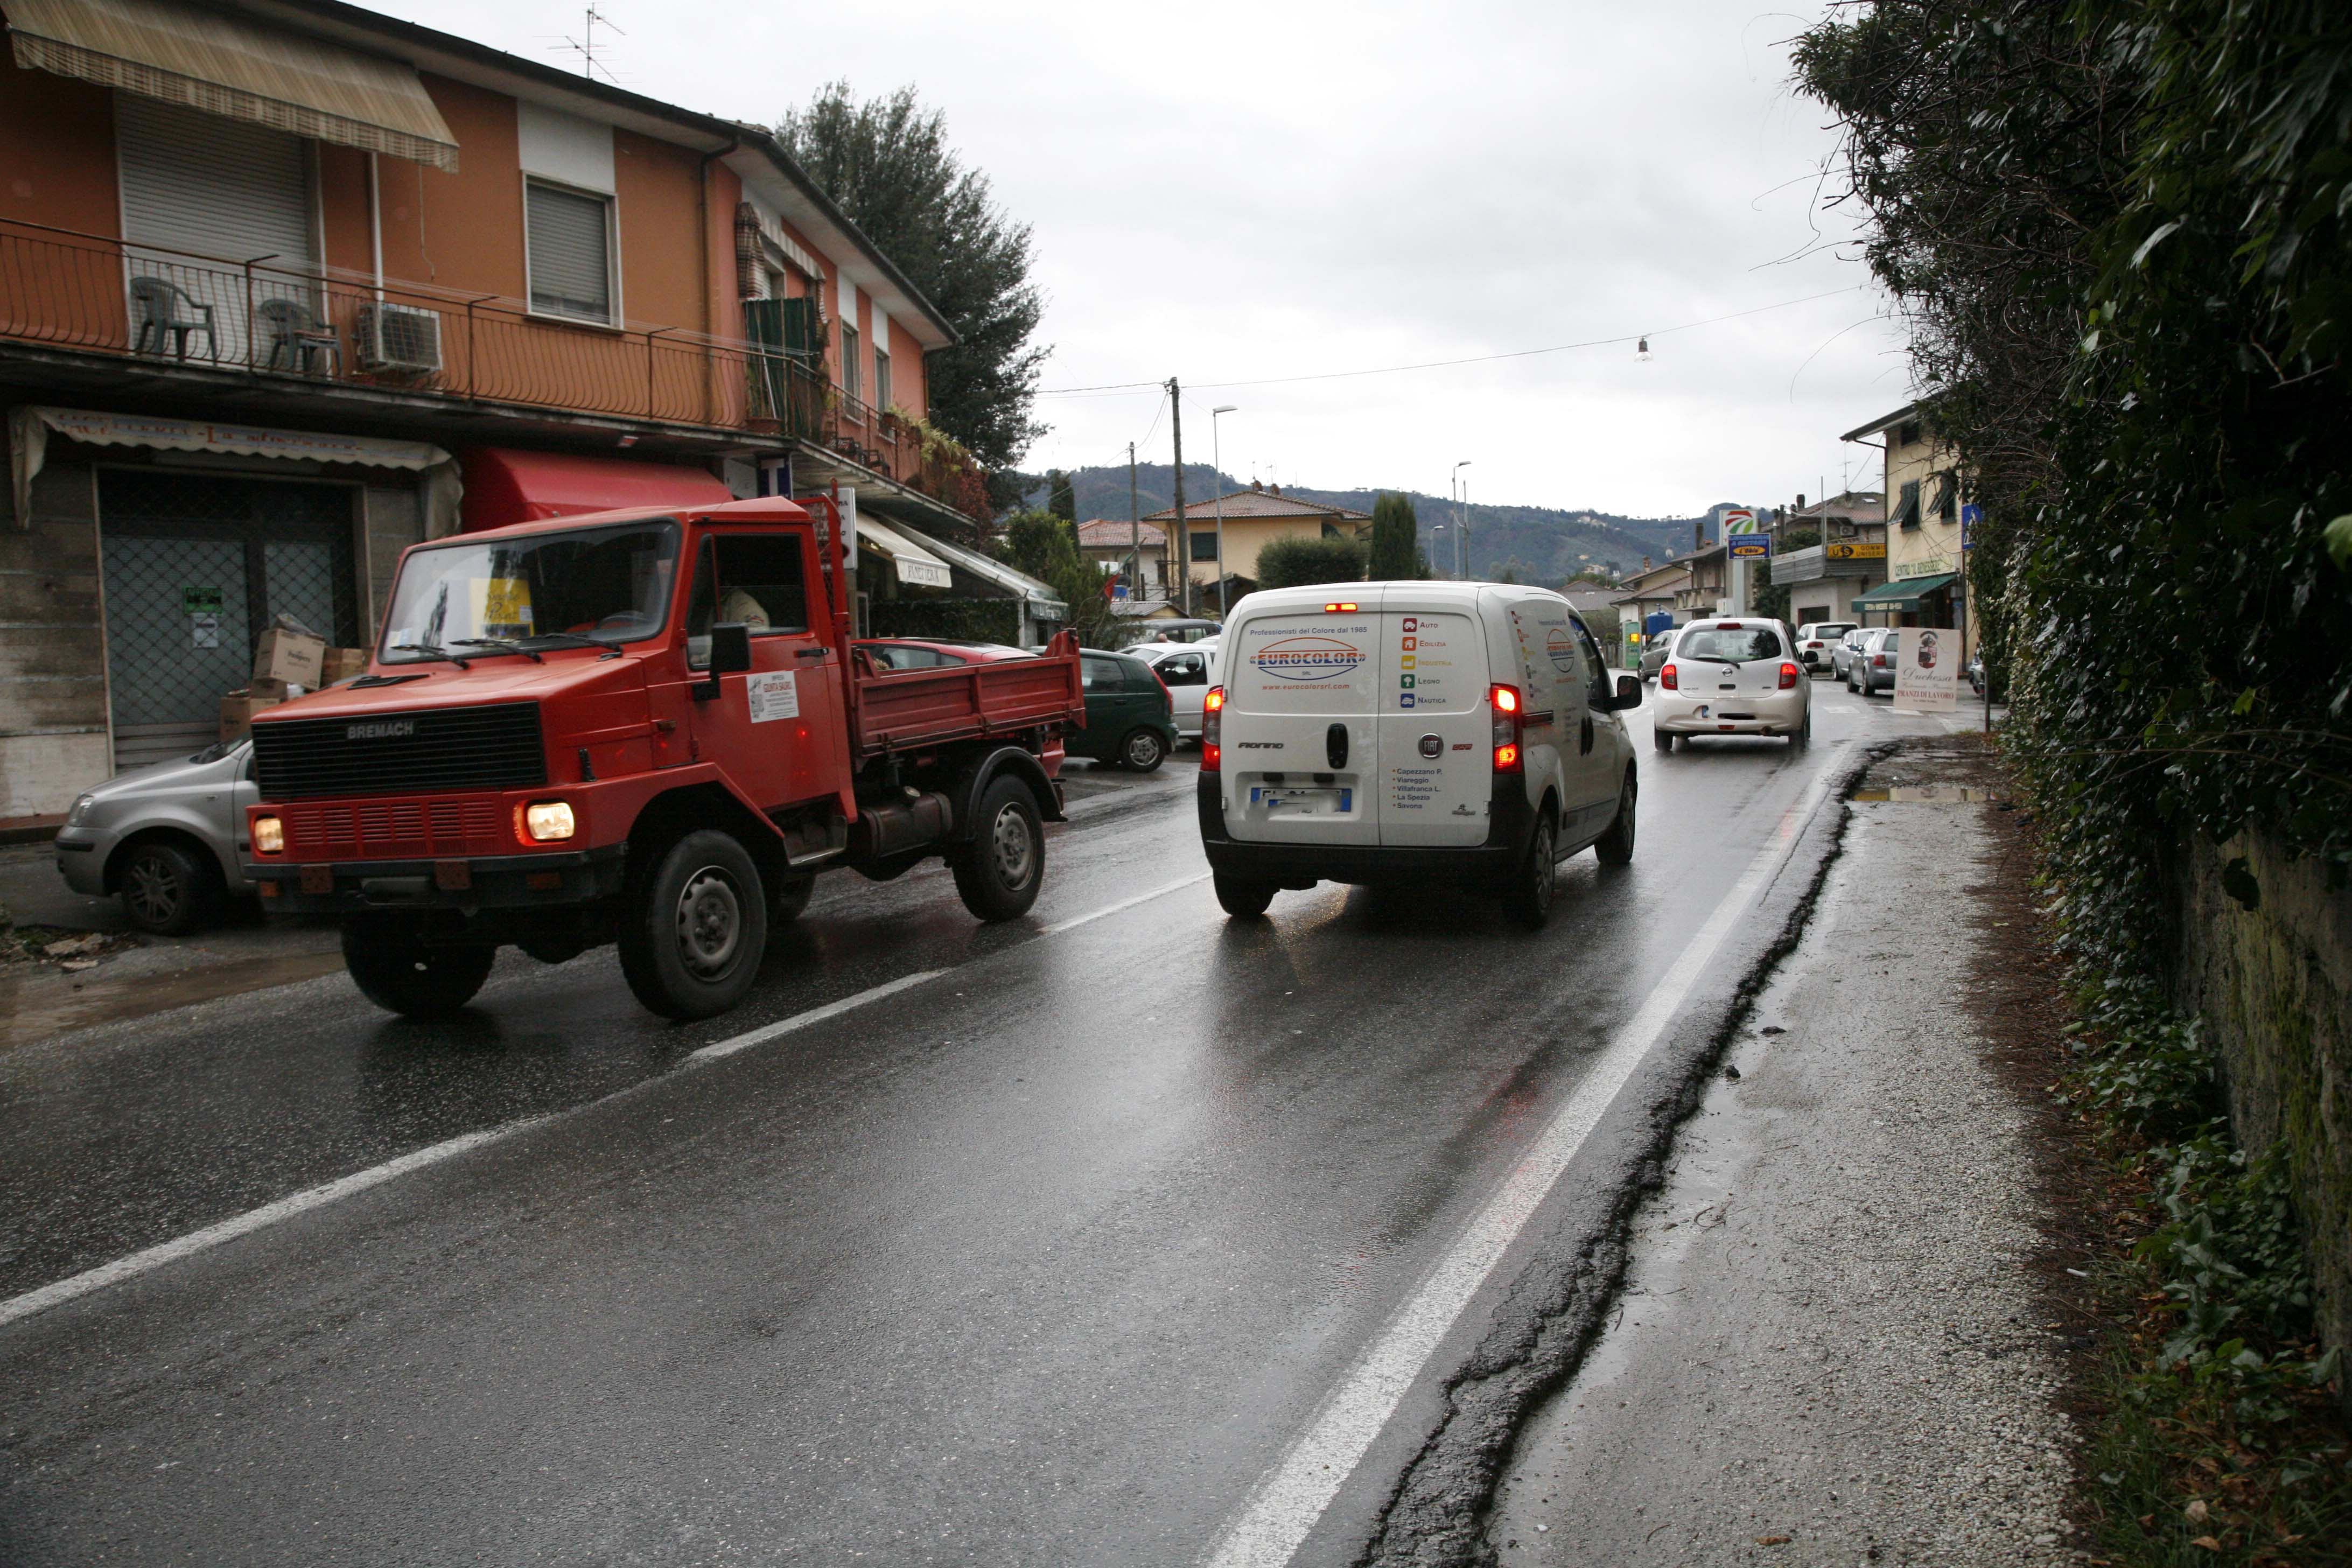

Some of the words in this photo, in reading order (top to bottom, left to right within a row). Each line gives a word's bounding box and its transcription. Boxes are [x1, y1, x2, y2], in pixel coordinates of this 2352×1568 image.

[1902, 667, 1952, 682] Duchessa
[1897, 690, 1920, 698] PRANZI
[1920, 690, 1928, 698] DI
[1928, 691, 1954, 699] LAVORO
[347, 720, 414, 740] BREMACH
[1424, 740, 1438, 752] FIAT
